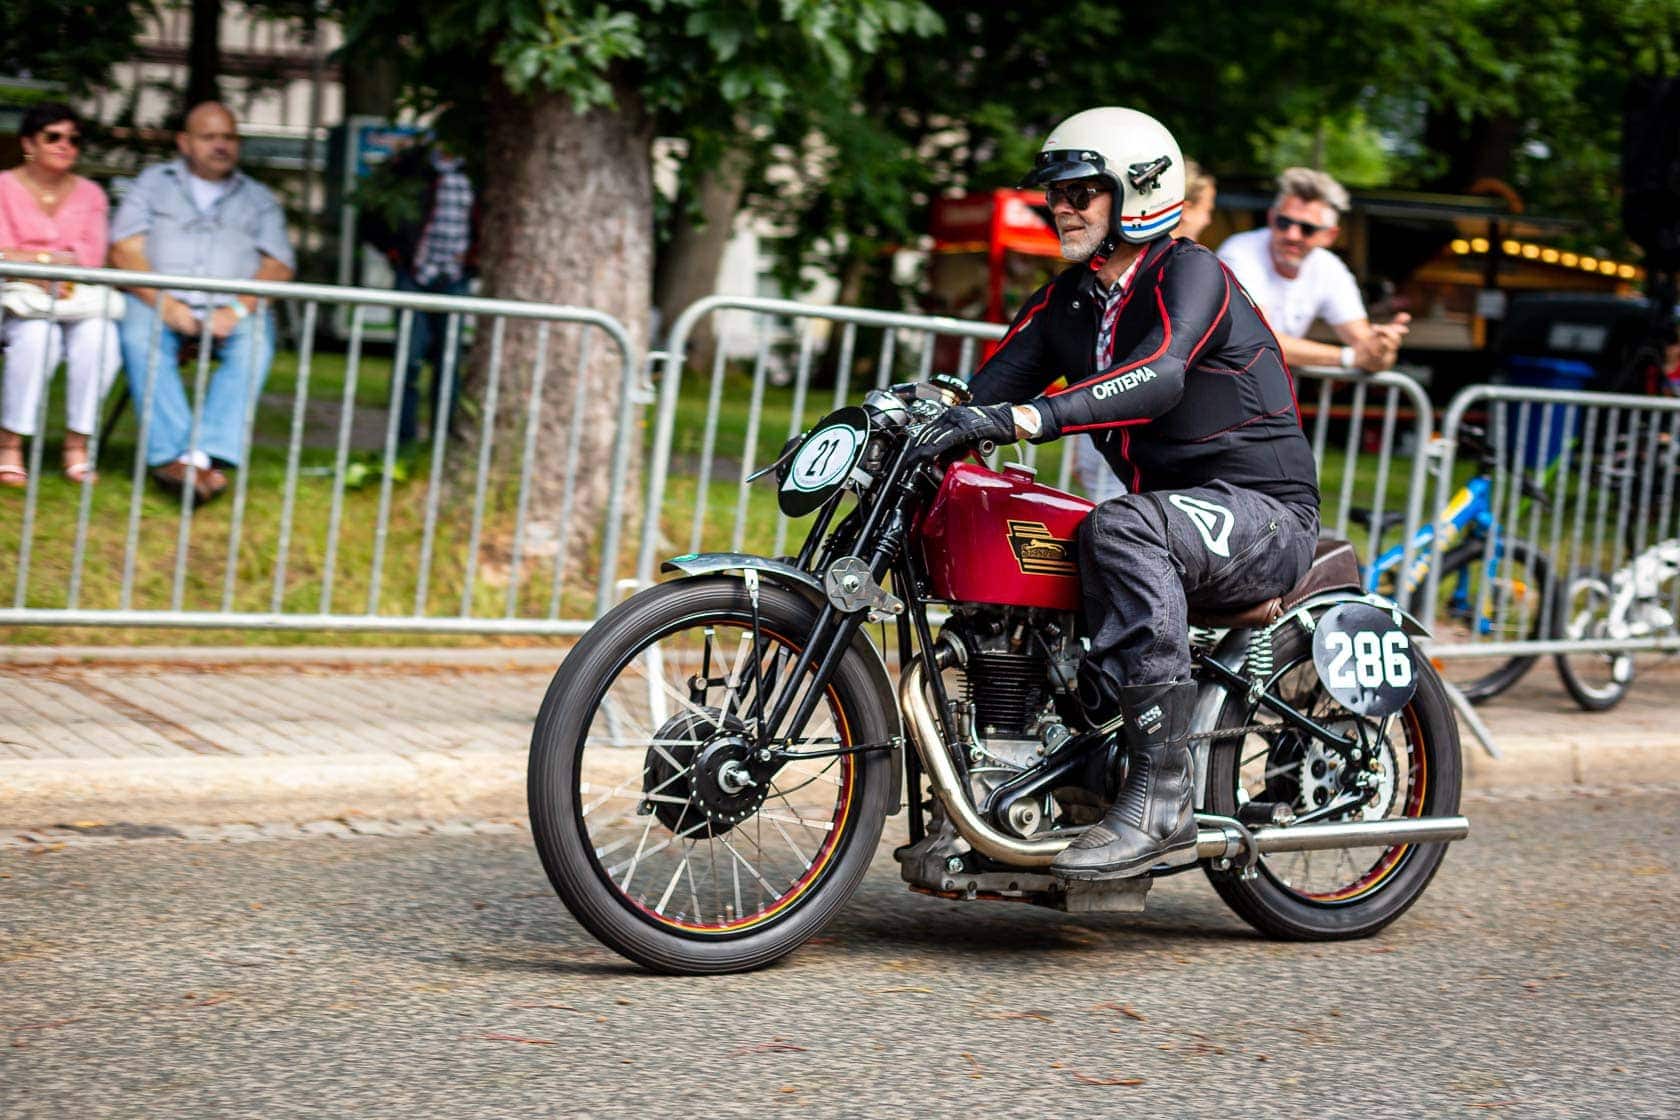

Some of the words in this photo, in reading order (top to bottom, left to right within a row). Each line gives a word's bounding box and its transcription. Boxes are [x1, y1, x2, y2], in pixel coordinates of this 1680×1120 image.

[1092, 366, 1157, 400] ORTEMA
[805, 439, 840, 476] 21
[1325, 631, 1412, 688] 286
